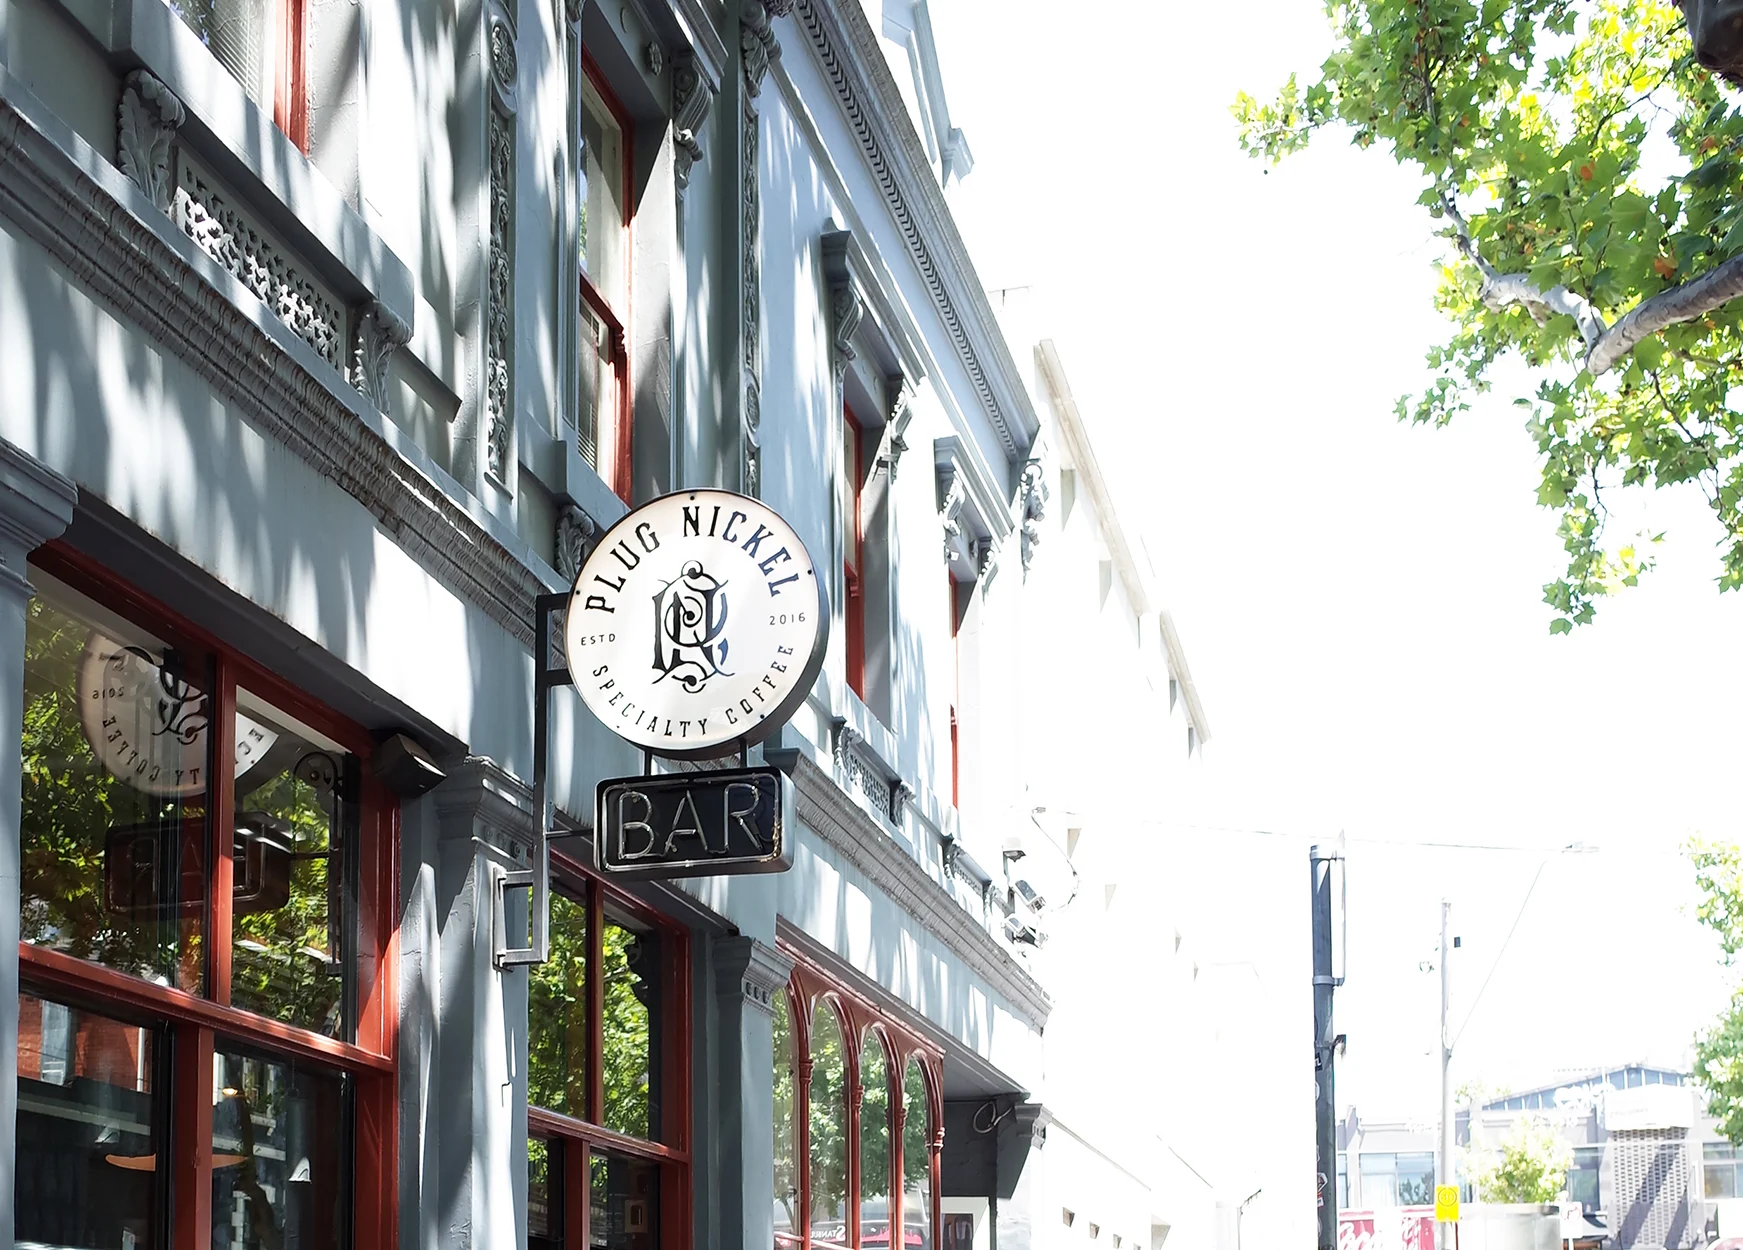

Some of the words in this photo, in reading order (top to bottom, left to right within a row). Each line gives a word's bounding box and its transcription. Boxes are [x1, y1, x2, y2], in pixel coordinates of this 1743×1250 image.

[584, 521, 661, 614] PLUG
[682, 505, 800, 598] NICKEL
[580, 632, 617, 647] ESTD
[769, 612, 806, 626] 2016
[592, 664, 708, 739] SPECIALTY
[725, 644, 794, 725] COFFEE
[617, 782, 765, 861] BAR
